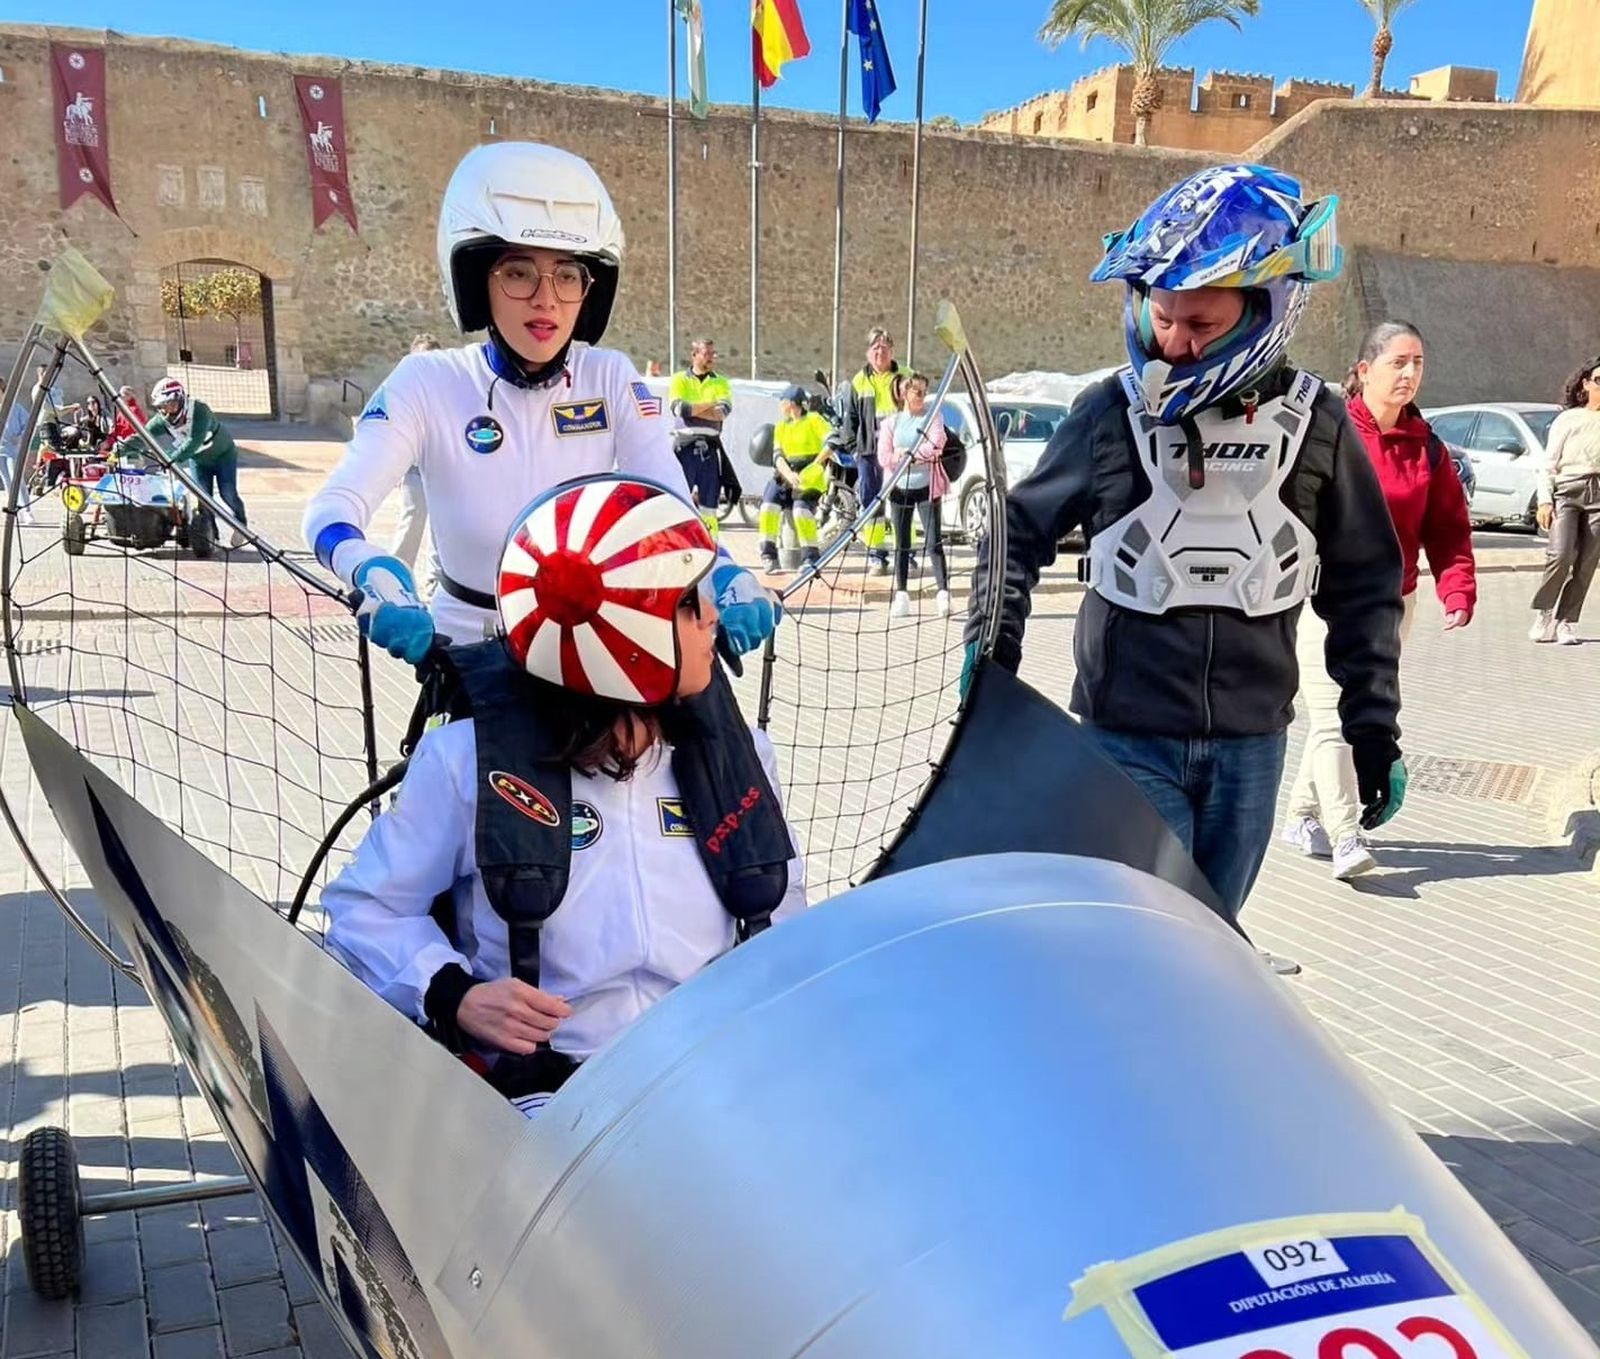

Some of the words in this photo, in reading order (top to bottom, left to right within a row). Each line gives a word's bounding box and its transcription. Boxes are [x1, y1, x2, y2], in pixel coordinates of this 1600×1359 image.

[1295, 374, 1313, 403] THOR
[1263, 1240, 1327, 1272] 092
[1228, 1283, 1319, 1313] DIPUTACIÓN
[1318, 1279, 1340, 1293] DE
[1340, 1272, 1396, 1290] ALMERÍA
